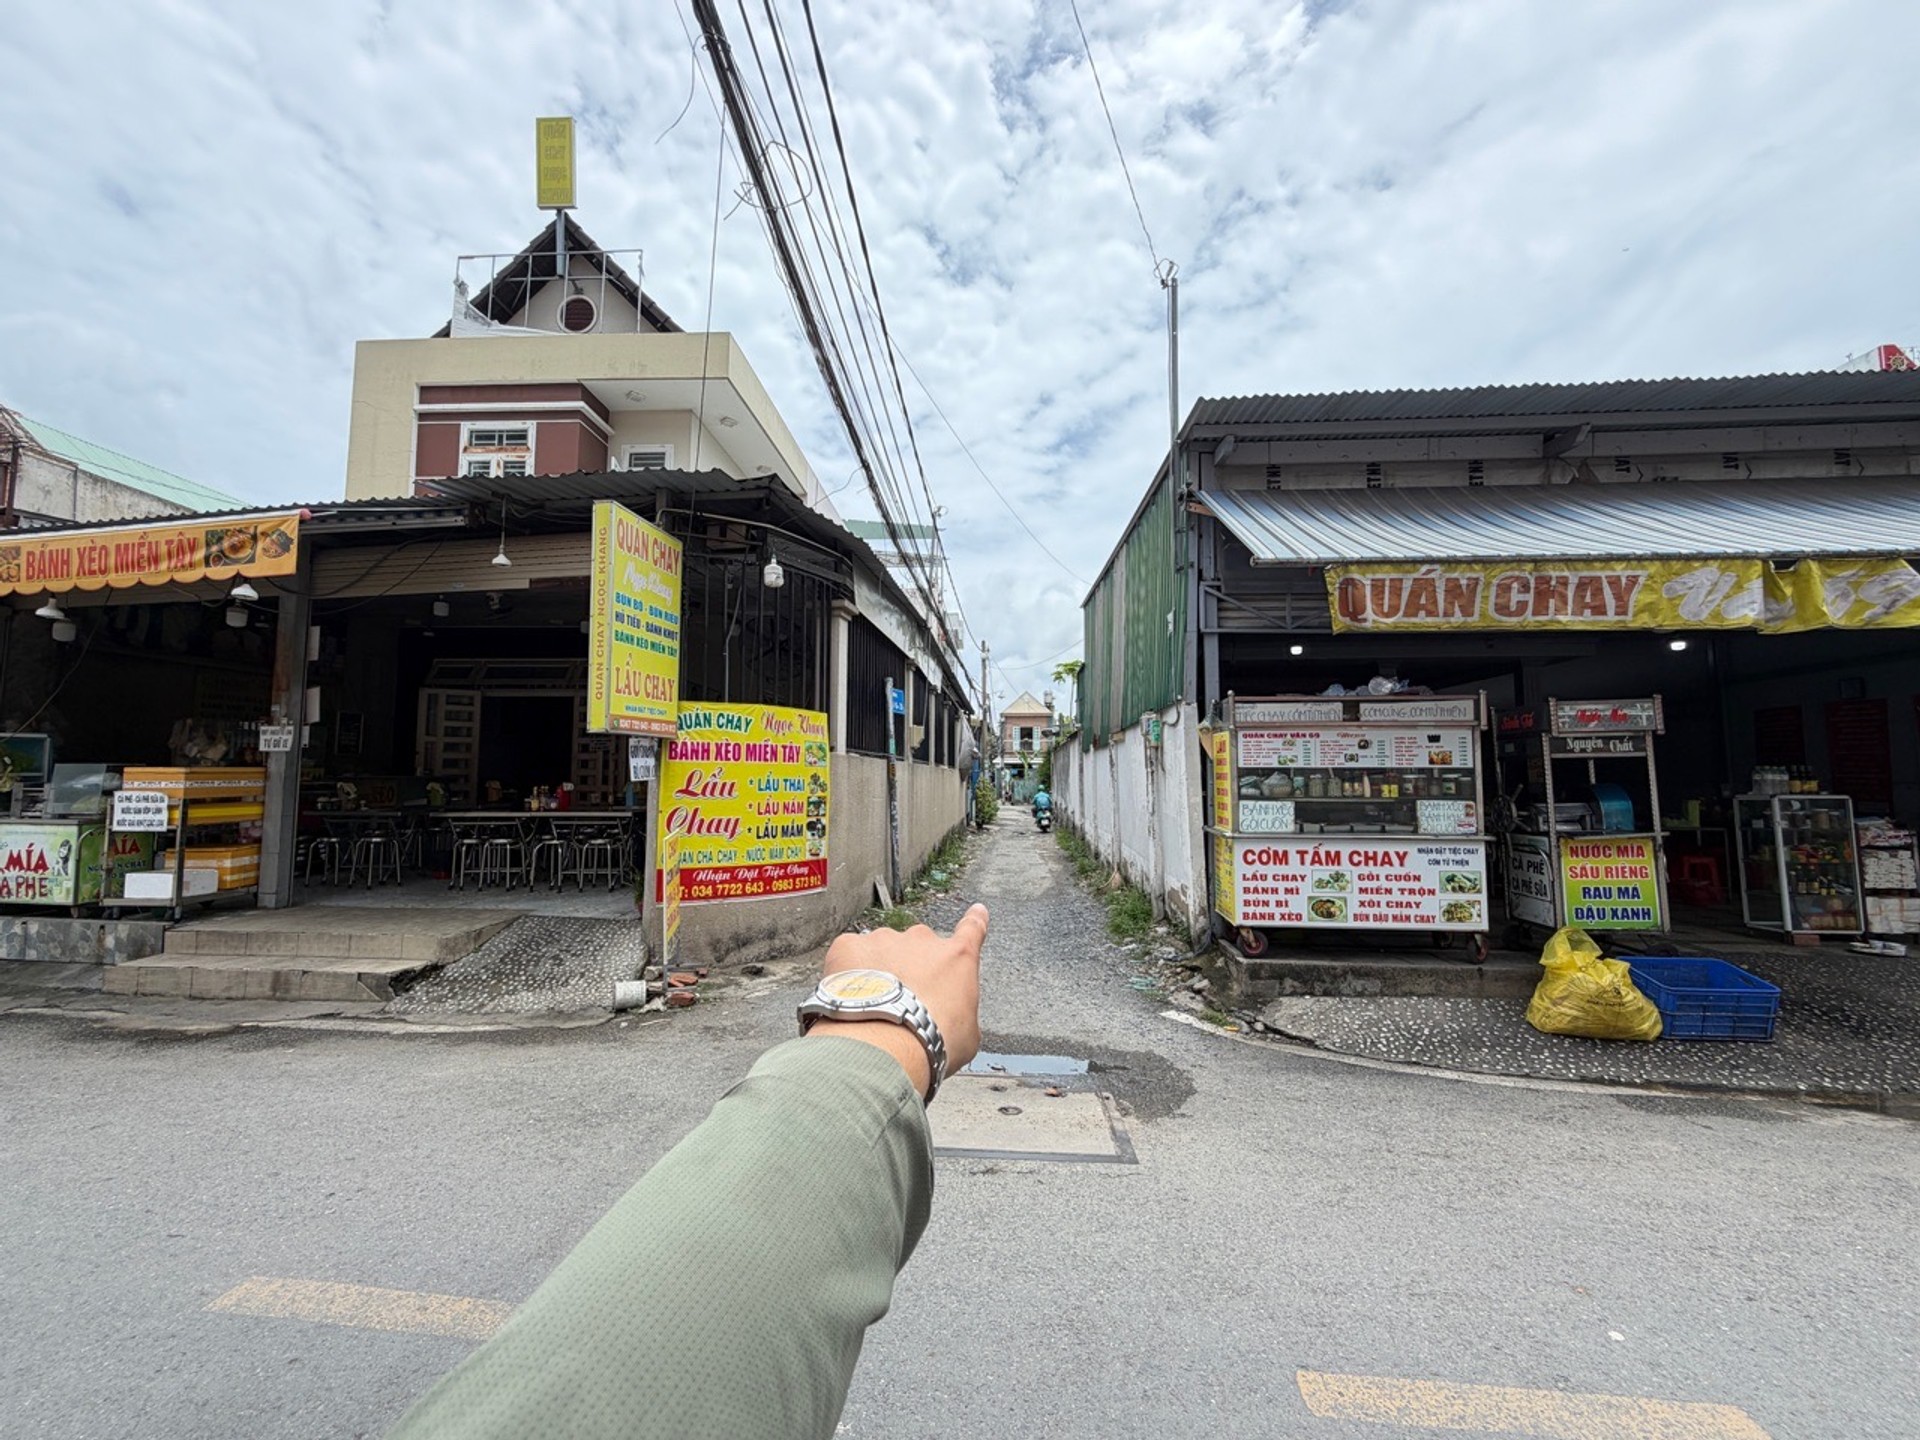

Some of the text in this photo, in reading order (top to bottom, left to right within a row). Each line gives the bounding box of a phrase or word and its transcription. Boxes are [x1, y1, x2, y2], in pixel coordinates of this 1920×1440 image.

[26, 531, 199, 582] BÁNH XÈO MIỀN TÂY
[598, 527, 608, 575] KHANG
[652, 538, 680, 576] CHAY
[1337, 568, 1480, 623] QUÁN
[1493, 574, 1641, 619] CHAY
[596, 621, 605, 658] CHAY
[644, 673, 675, 703] CHAY
[716, 712, 753, 733] CHAY
[668, 736, 711, 761] BÁNH
[714, 738, 741, 762] XÈO
[745, 739, 778, 763] MIỀN
[781, 741, 801, 763] TÂY
[1566, 736, 1634, 753] Nguyên Chất
[674, 767, 739, 799] Lẩu
[757, 771, 806, 792] LẨU THÁI
[757, 794, 804, 816] LẨU NẤM
[665, 806, 741, 840] Chay
[756, 816, 779, 839] LẨU
[4, 842, 50, 873] MÍA
[717, 848, 737, 863] CHAY
[1242, 842, 1409, 867] CƠM TẤM CHAY
[1463, 847, 1479, 855] CHAY
[1569, 842, 1645, 859] NƯỚC MÍA
[1242, 870, 1308, 882] LẨU CHAY
[1385, 871, 1422, 882] CUỐN
[1527, 859, 1545, 875] PHÊ
[1569, 862, 1649, 880] SẦU RIÊNG
[691, 886, 713, 897] 034
[717, 883, 745, 896] 7722
[745, 881, 765, 894] 643
[772, 879, 794, 892] 0983
[794, 876, 810, 889] 573
[1242, 884, 1300, 895] BÁNH MÌ
[1358, 884, 1437, 898] MIẾN TRỘN
[1582, 883, 1641, 900] RAU MÁ
[1243, 897, 1290, 908] BÚN BÌ
[1358, 898, 1422, 909] XÔI CHAY
[1242, 910, 1303, 921] BÁNH XÈO
[1352, 911, 1370, 923] BÚN
[1414, 914, 1437, 924] CHAY
[1574, 906, 1652, 923] ĐẬU XANH
